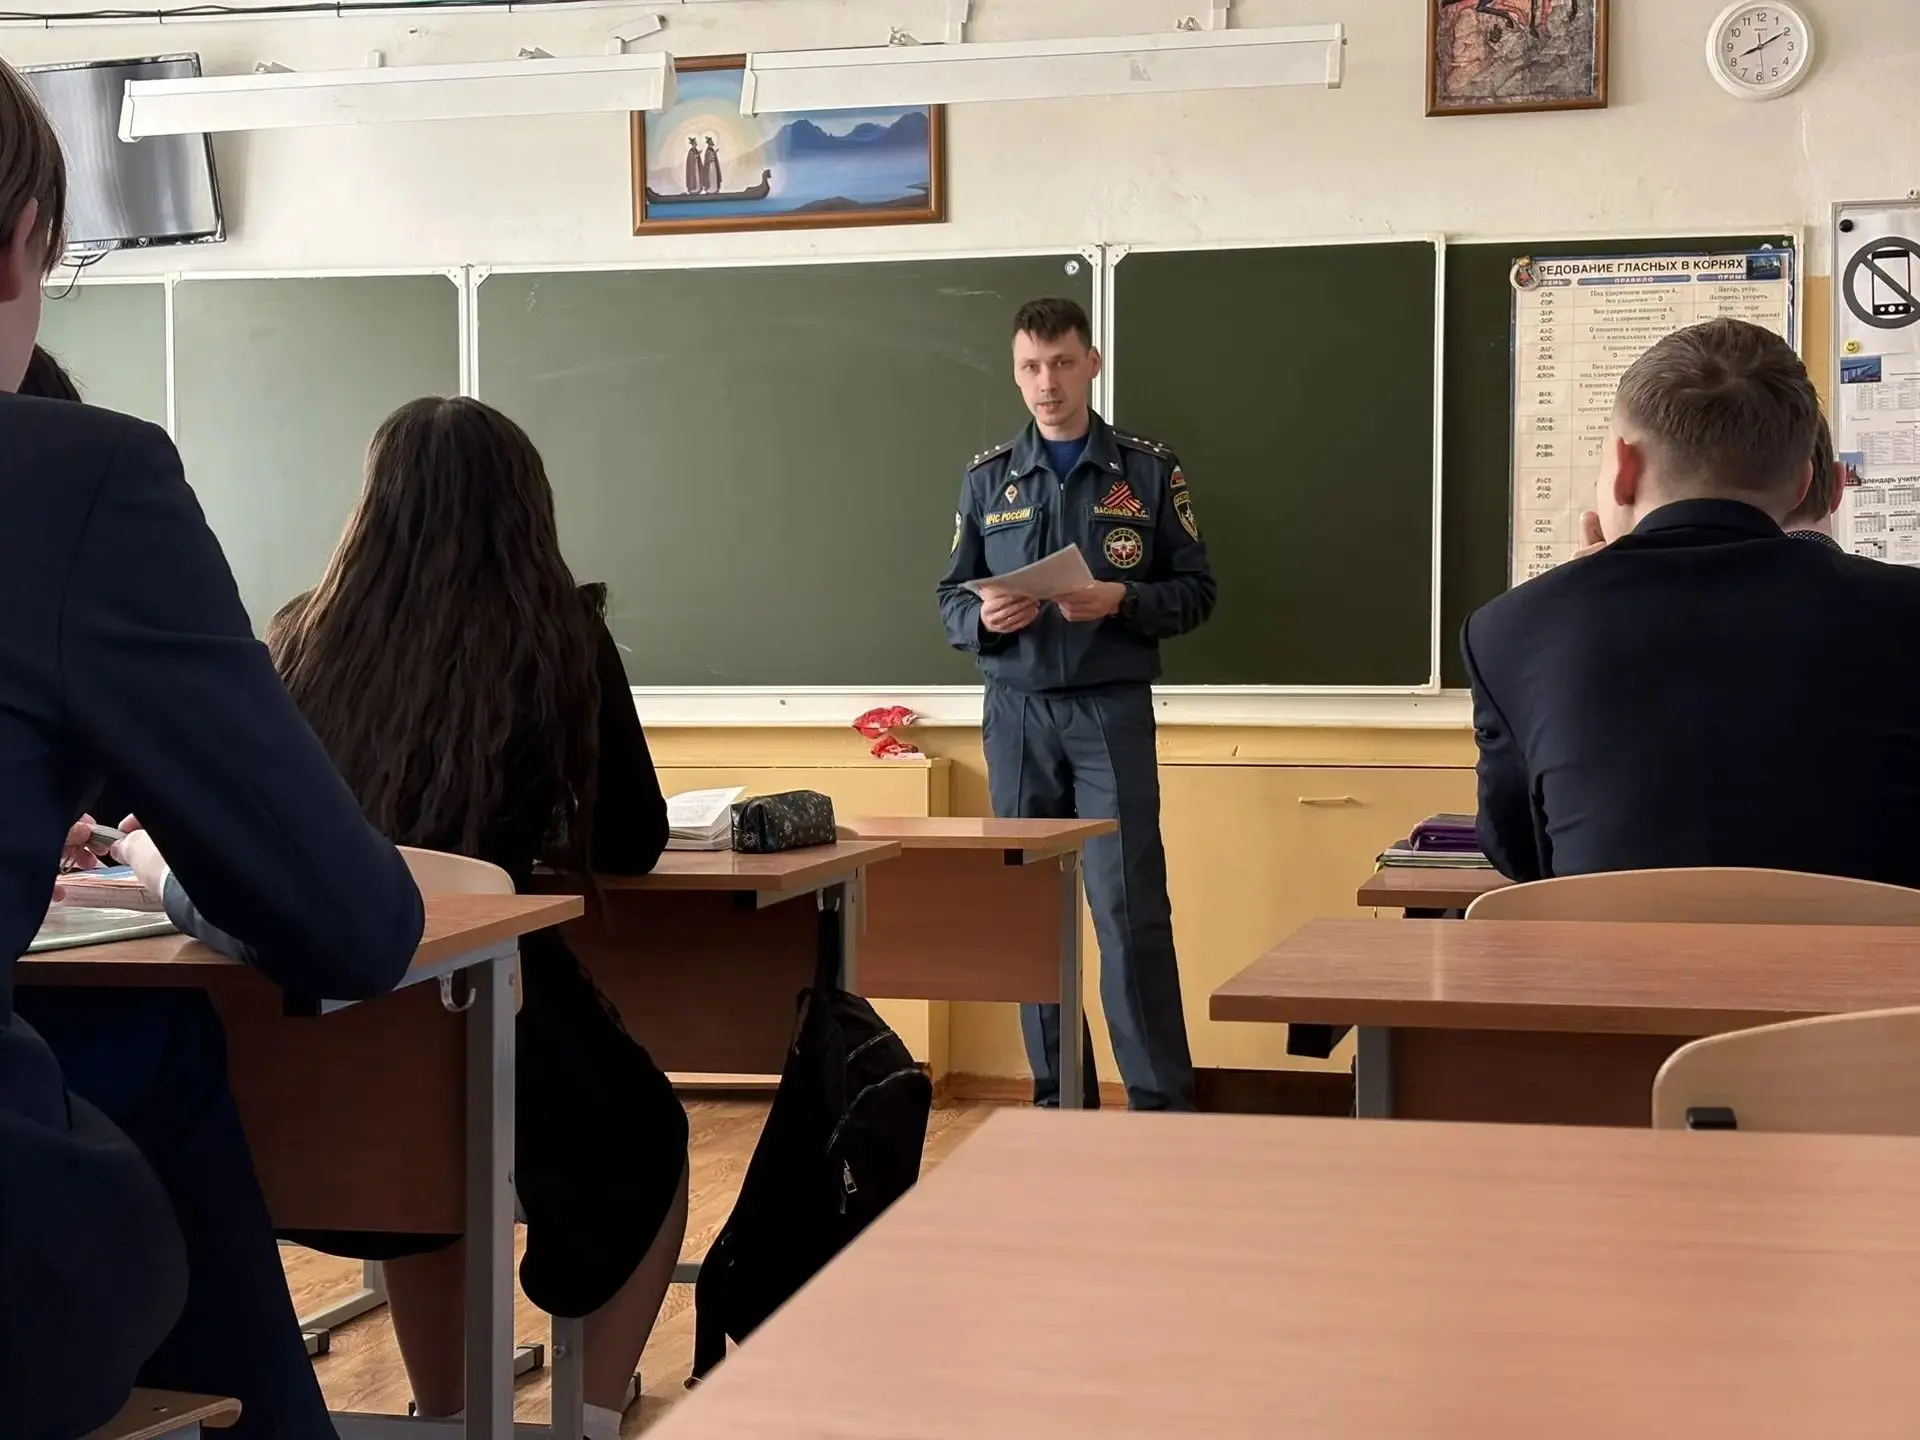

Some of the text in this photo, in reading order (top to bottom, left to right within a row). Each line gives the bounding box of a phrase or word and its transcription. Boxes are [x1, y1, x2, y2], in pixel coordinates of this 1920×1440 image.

[1742, 17, 1751, 26] 11
[1756, 12, 1767, 22] 12
[1774, 16, 1779, 25] 1
[1730, 28, 1741, 38] 10
[1783, 26, 1791, 36] 2
[1726, 43, 1734, 52] 9
[1787, 41, 1794, 51] 3
[1730, 57, 1738, 67] 8
[1782, 56, 1789, 66] 4
[1741, 68, 1748, 78] 7
[1756, 71, 1763, 81] 6
[1771, 67, 1778, 77] 5
[1539, 259, 1744, 276] РЕДОВАНИЕ ГЛАСНЫХ В КОРНЯХ
[1001, 507, 1031, 522] РОССИИ
